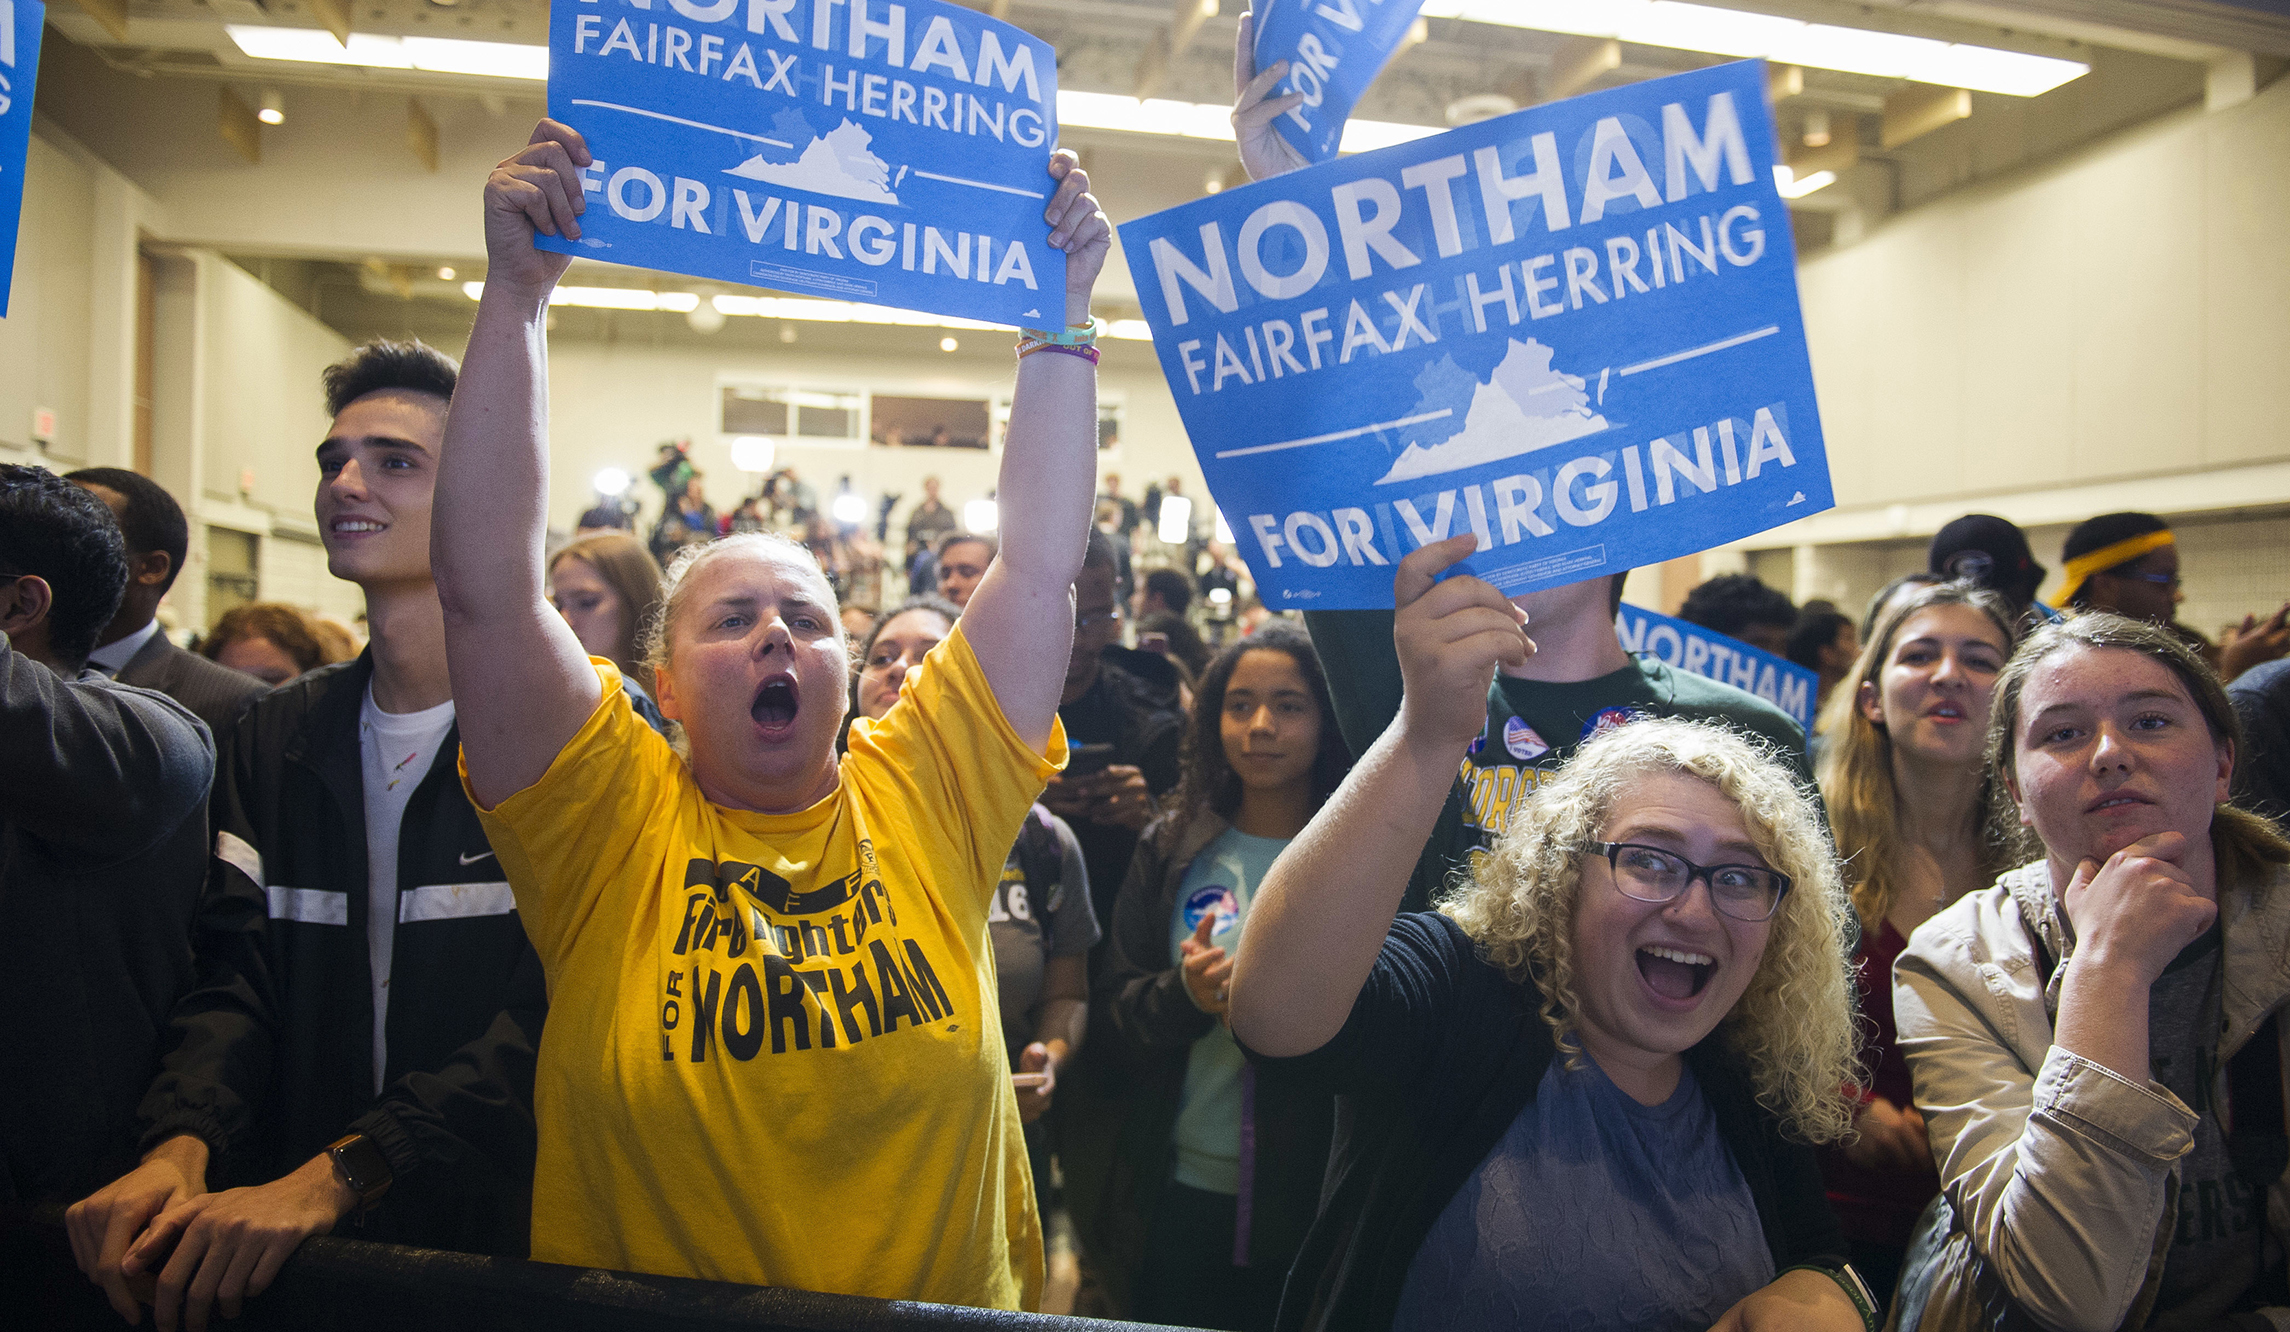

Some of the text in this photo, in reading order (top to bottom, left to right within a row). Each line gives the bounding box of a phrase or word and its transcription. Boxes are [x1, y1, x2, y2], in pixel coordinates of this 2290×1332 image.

[574, 13, 1047, 149] FAIRFAX HERRING
[578, 159, 712, 235] FOR
[732, 188, 1039, 291] VIRGINIA
[1148, 91, 1757, 327] NORTHAM
[1177, 205, 1767, 396] FAIRFAX HERRING
[1247, 507, 1390, 569] FOR
[1393, 406, 1798, 553] VIRGINIA
[1614, 609, 1809, 723] NORTHAM
[662, 969, 684, 1062] FOR
[690, 935, 955, 1063] NORTHAM
